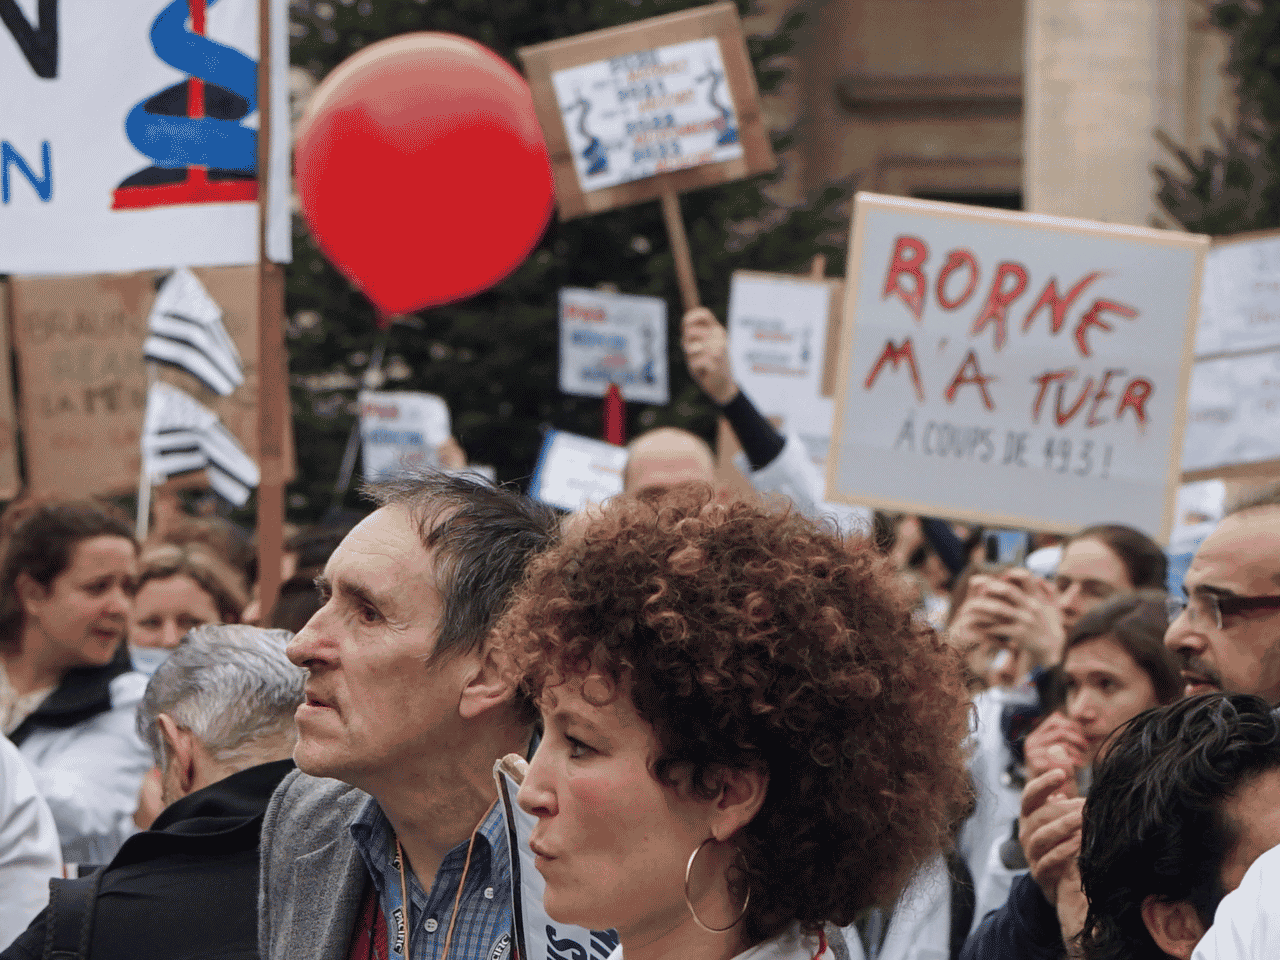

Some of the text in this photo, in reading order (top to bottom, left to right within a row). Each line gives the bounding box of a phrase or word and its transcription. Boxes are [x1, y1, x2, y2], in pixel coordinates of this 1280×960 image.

[882, 235, 1140, 358] BORNE
[1030, 366, 1154, 438] TUER
[922, 419, 994, 463] COUPS
[1001, 430, 1030, 467] DE
